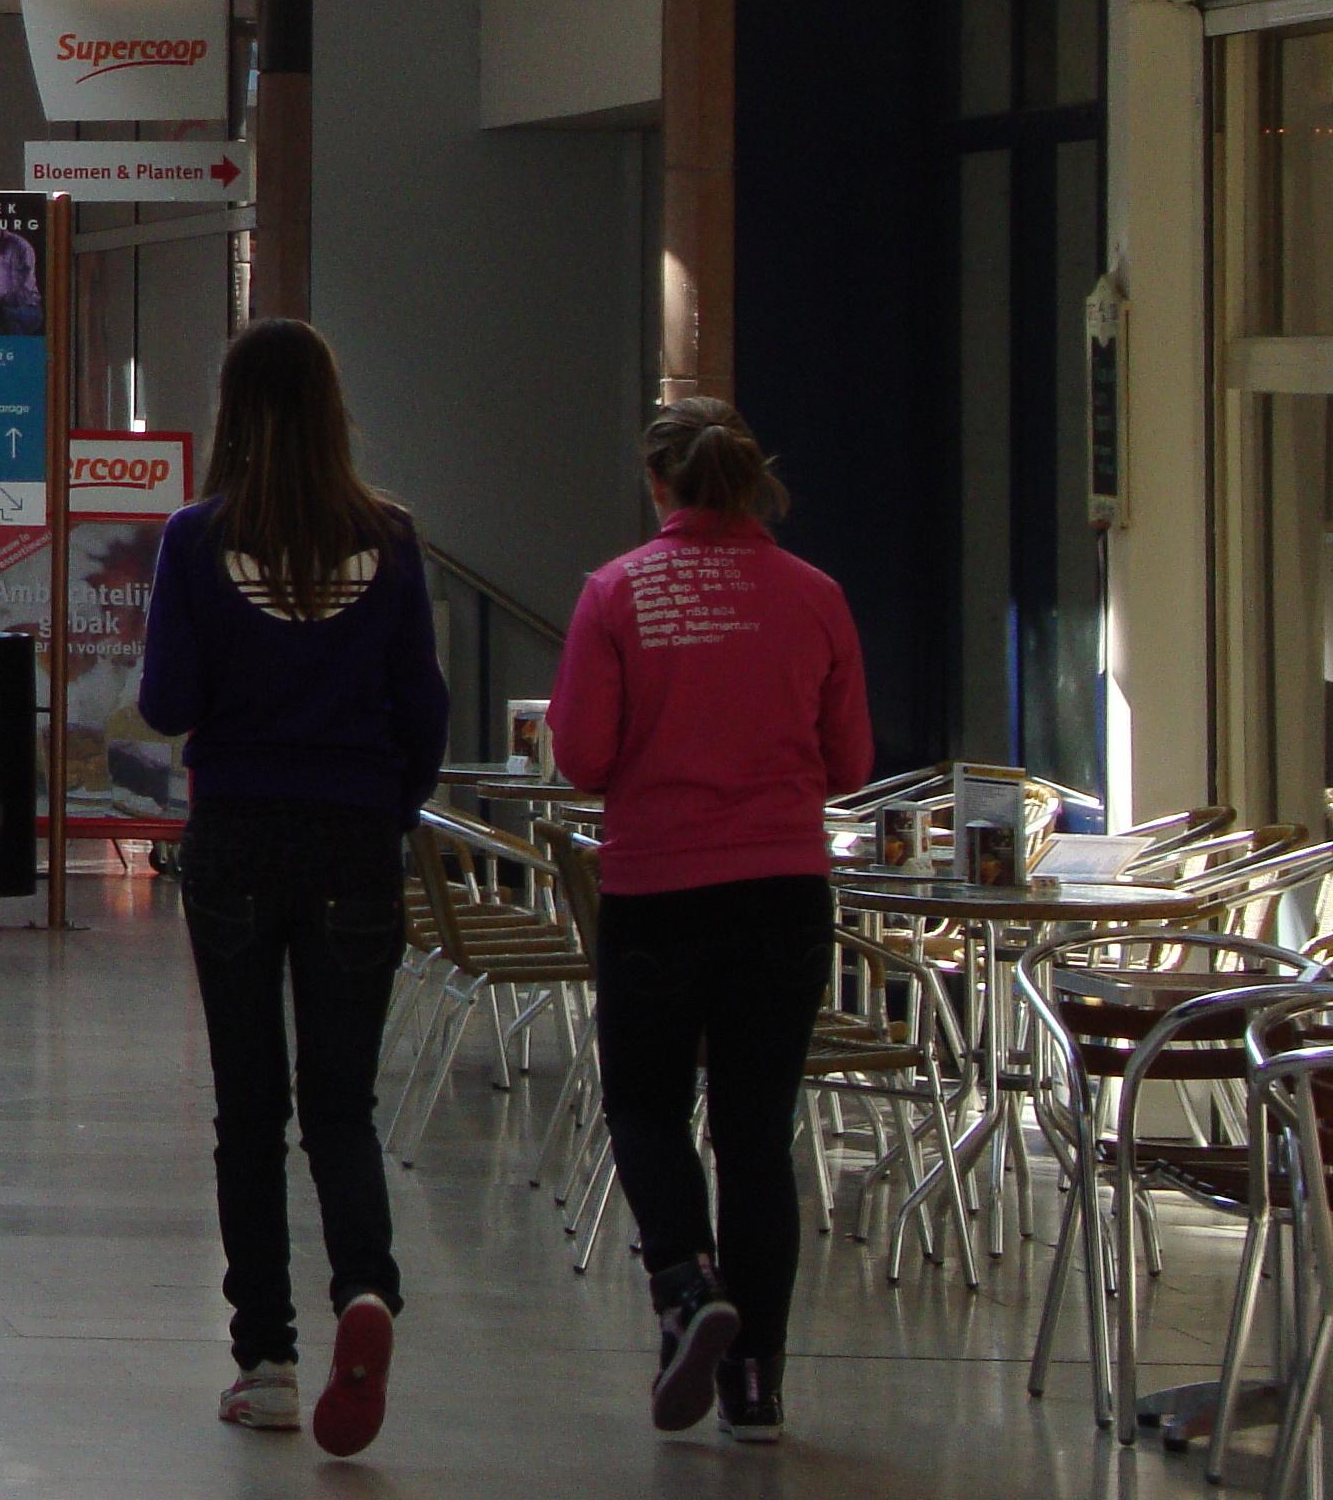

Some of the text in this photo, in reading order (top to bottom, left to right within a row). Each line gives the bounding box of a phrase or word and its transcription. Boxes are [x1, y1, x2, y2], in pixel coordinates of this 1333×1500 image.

[55, 33, 208, 66] Supercoop
[34, 163, 204, 180] Bloemen & Planten
[70, 458, 169, 489] rcoop
[38, 610, 120, 638] gbak
